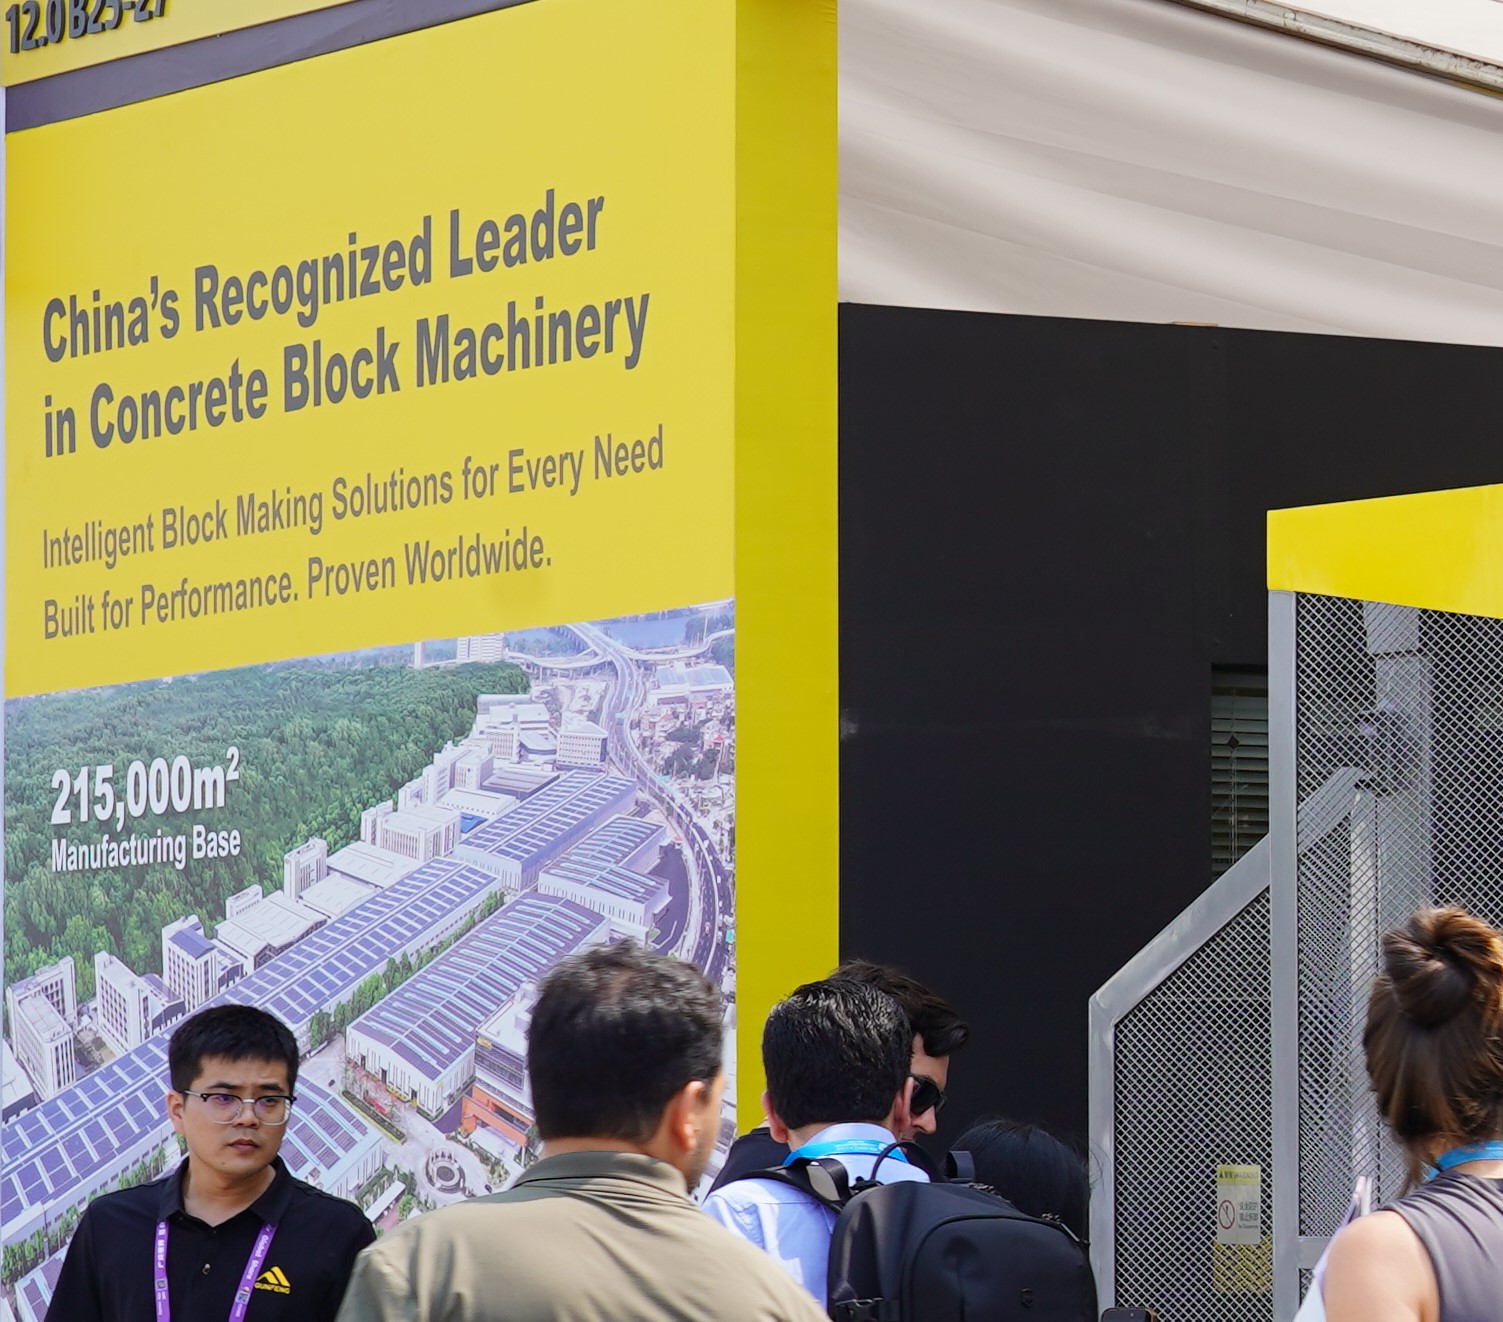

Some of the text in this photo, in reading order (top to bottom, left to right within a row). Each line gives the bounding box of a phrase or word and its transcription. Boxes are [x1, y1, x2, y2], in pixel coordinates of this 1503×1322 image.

[5, 0, 65, 54] 12.0
[194, 214, 432, 331] Recognized
[449, 188, 606, 279] Leader
[44, 293, 651, 458] in Concrete Block Machinery
[43, 424, 664, 569] Intelligent Block Making Solutions for Every Need
[43, 526, 553, 641] Built for Performance. Proven Worldwide.
[51, 824, 242, 872] Manufacturing Base
